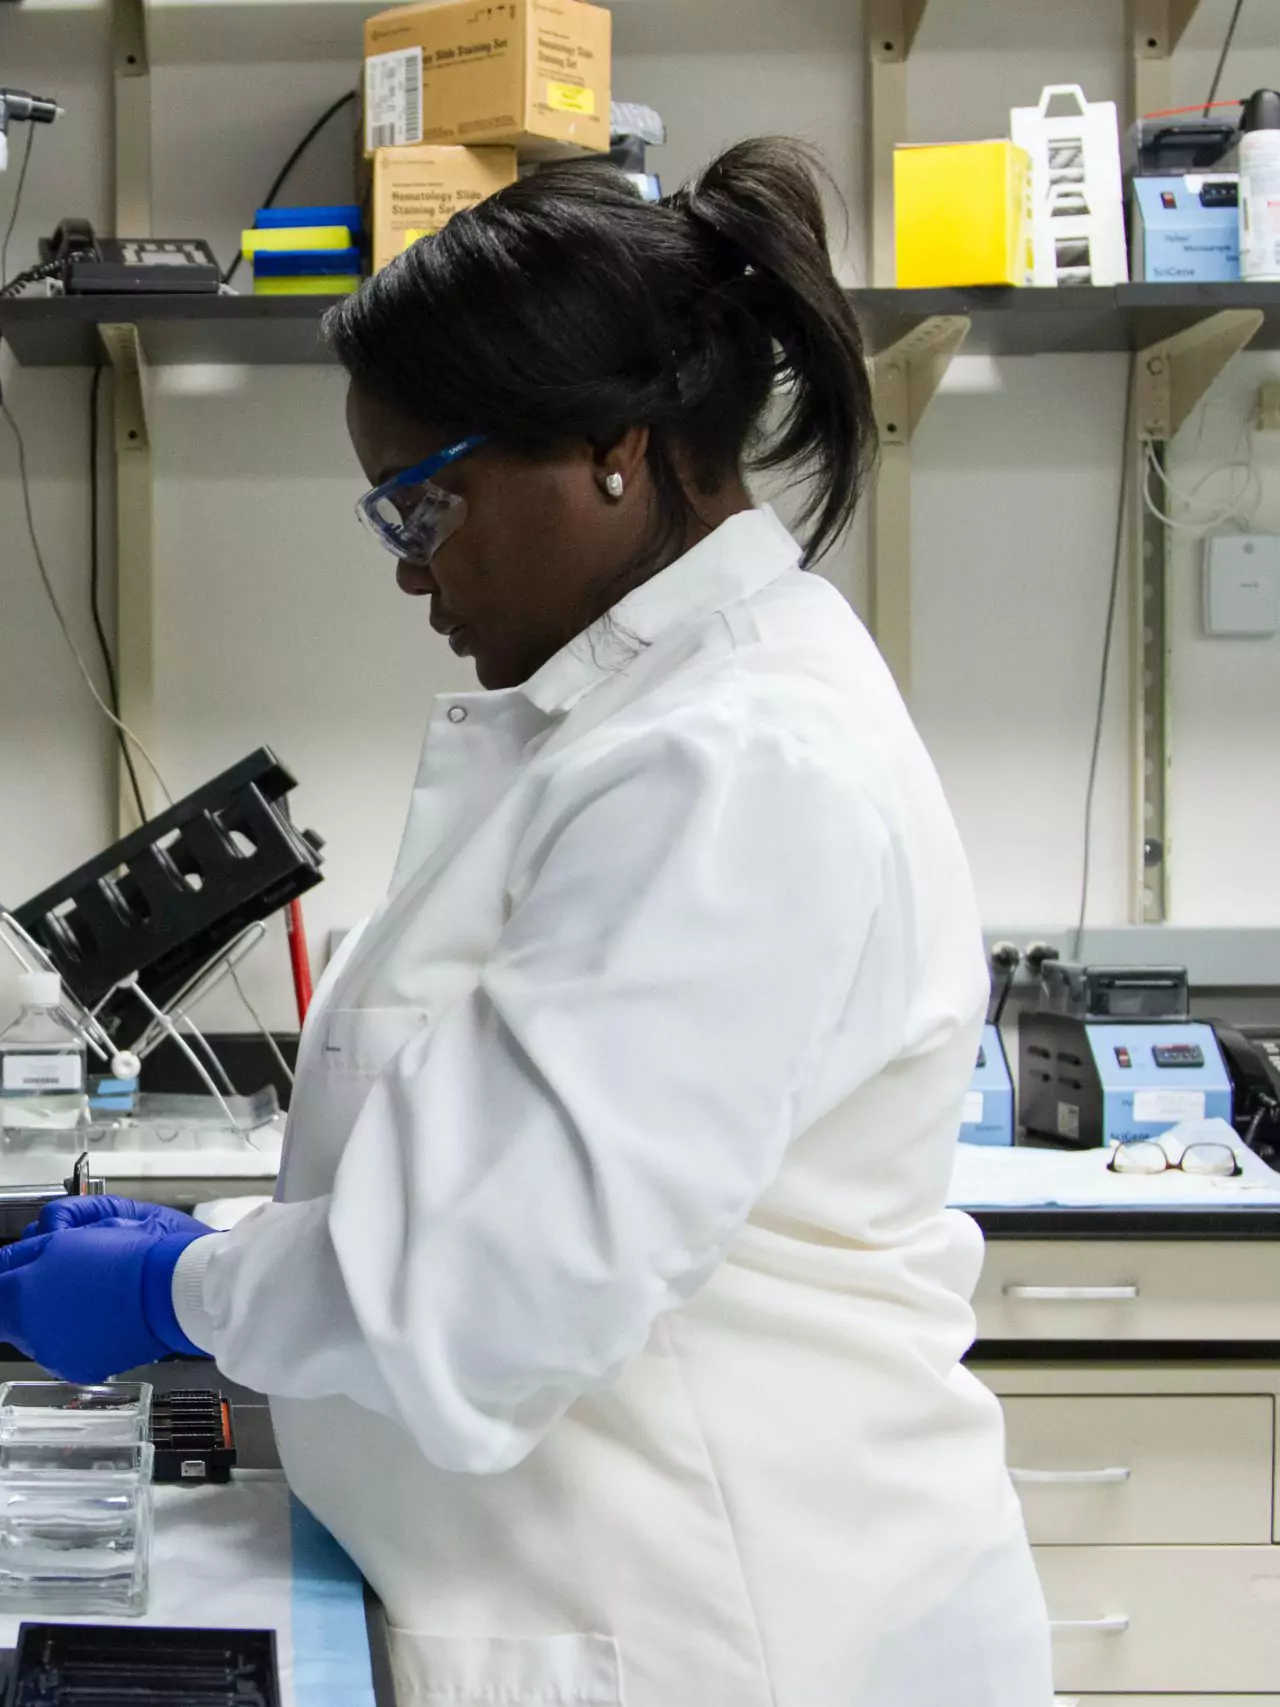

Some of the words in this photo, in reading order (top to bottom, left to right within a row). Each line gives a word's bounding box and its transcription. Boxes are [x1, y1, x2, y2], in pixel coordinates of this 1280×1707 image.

[493, 37, 508, 50] Set
[392, 190, 453, 203] Hematology
[392, 205, 435, 217] Staining
